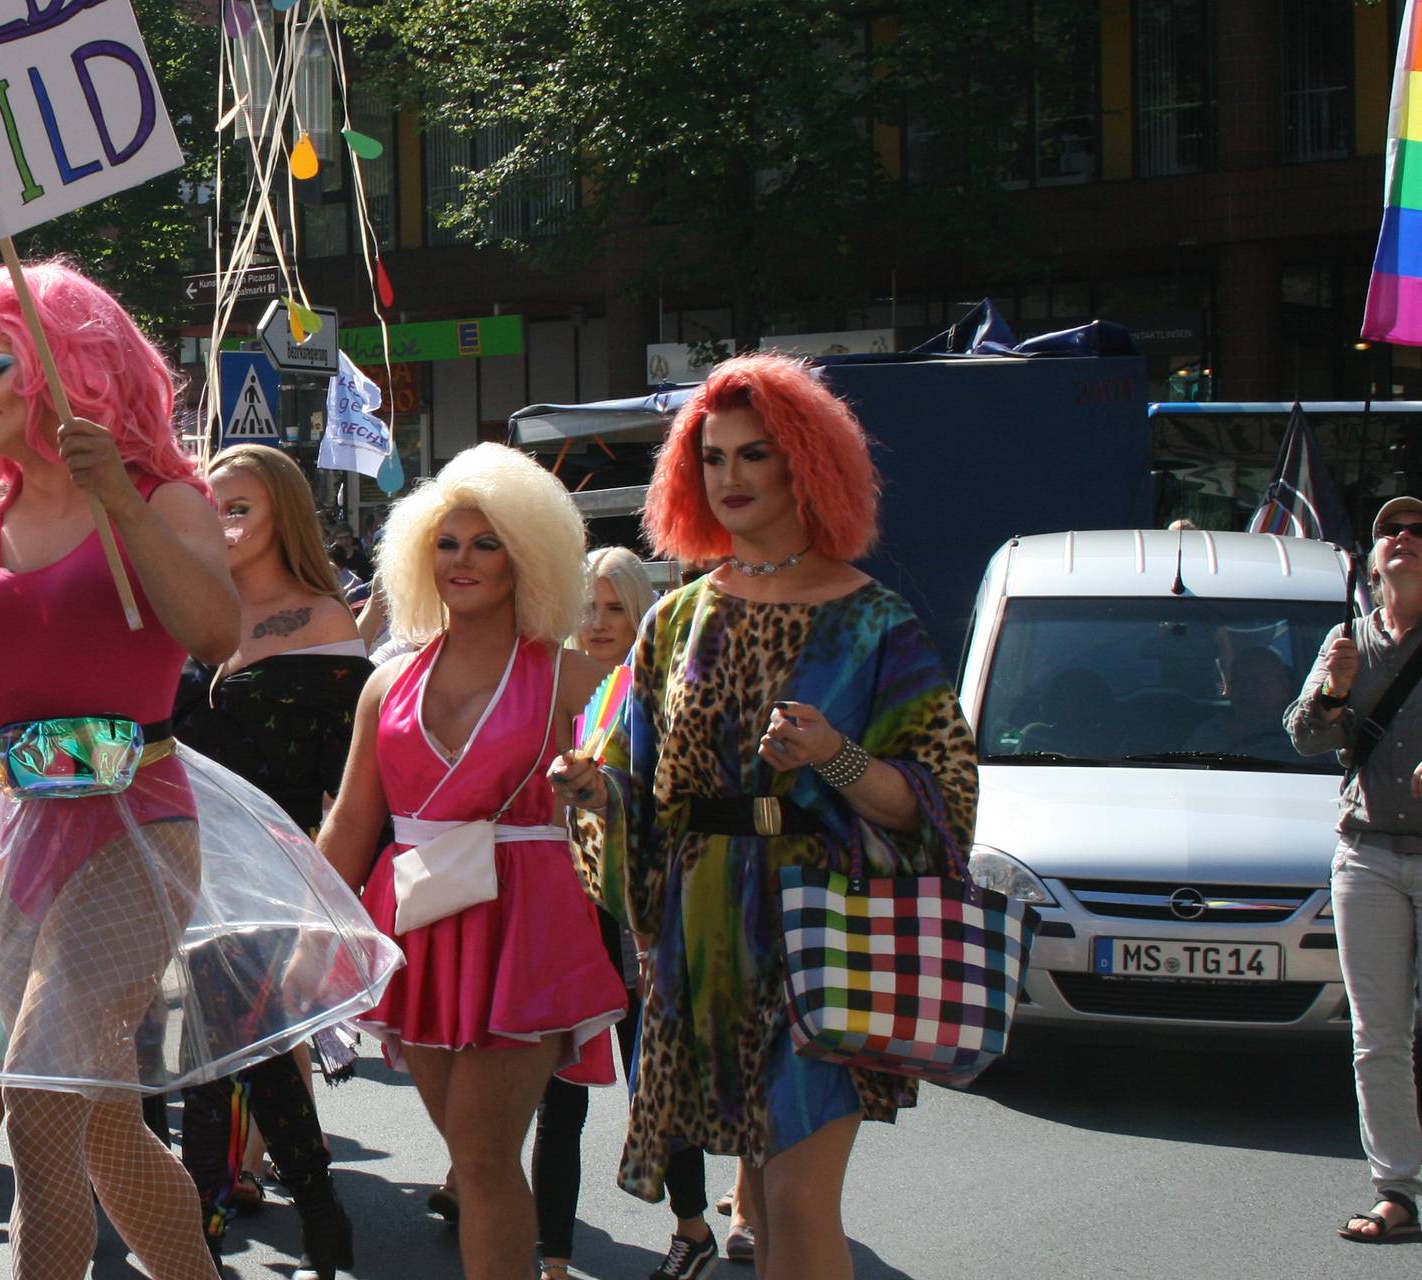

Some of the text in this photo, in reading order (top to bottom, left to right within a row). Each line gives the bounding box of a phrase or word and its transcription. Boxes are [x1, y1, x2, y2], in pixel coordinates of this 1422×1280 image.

[248, 273, 275, 284] Picasso
[1123, 944, 1161, 971] MS
[1183, 946, 1221, 974] TG
[1228, 948, 1264, 976] 14
